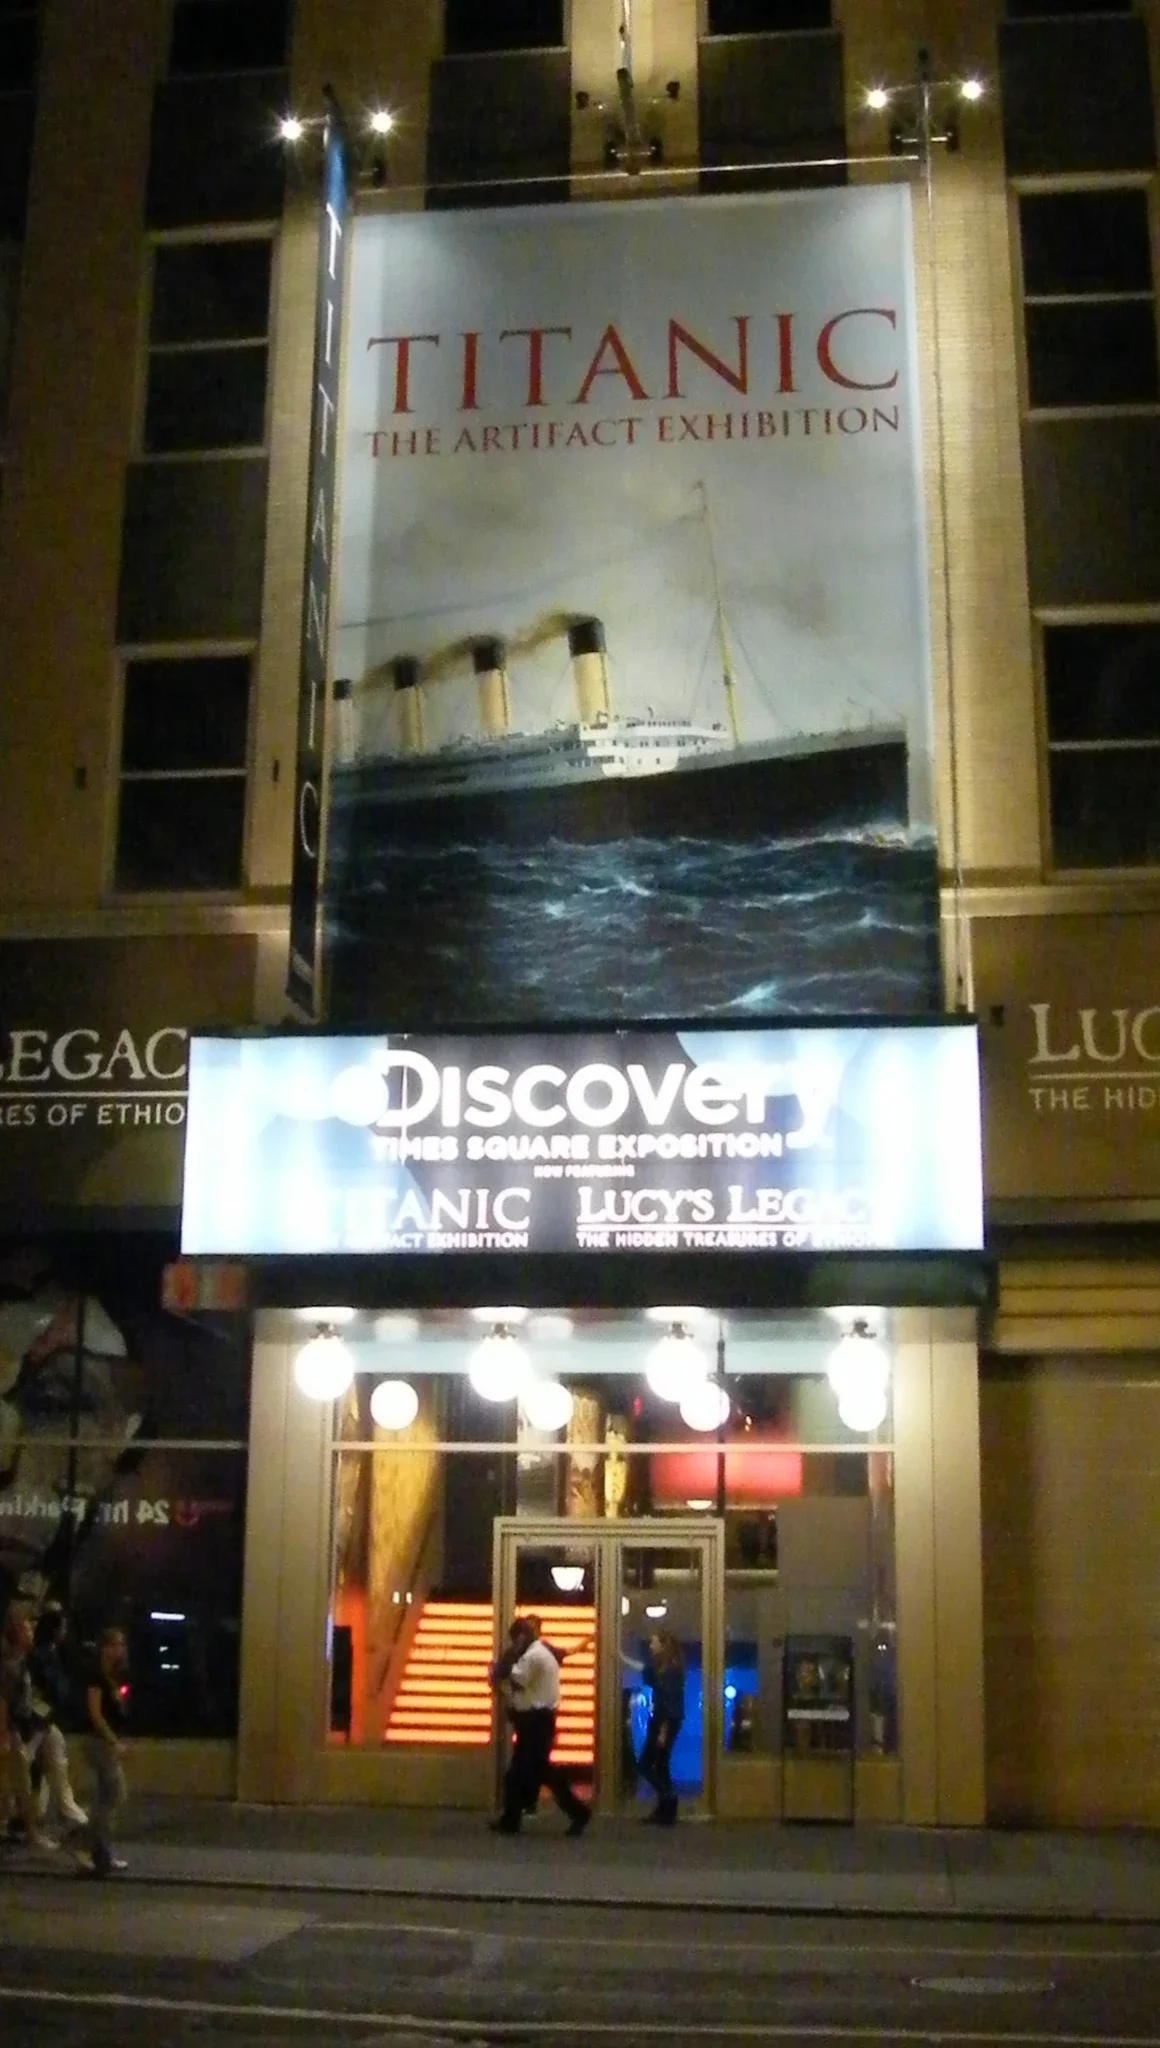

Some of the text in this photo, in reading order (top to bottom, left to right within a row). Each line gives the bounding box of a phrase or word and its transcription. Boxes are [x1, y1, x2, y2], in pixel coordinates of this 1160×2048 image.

[367, 308, 899, 414] TITANIC
[364, 405, 899, 457] THE ARTIFACT EXHIBITION
[301, 202, 341, 859] TITANIC
[0, 1028, 188, 1081] EGAC
[0, 1105, 36, 1126] ES
[47, 1104, 87, 1126] OF
[1028, 1086, 1160, 1110] THE HID
[371, 1133, 784, 1162] TIMES SQUARE EXPOSITION
[576, 1185, 716, 1223] LUCY'S
[576, 1231, 610, 1248] THE
[614, 1231, 679, 1248] HIDDEN
[682, 1230, 778, 1248] TREASURES
